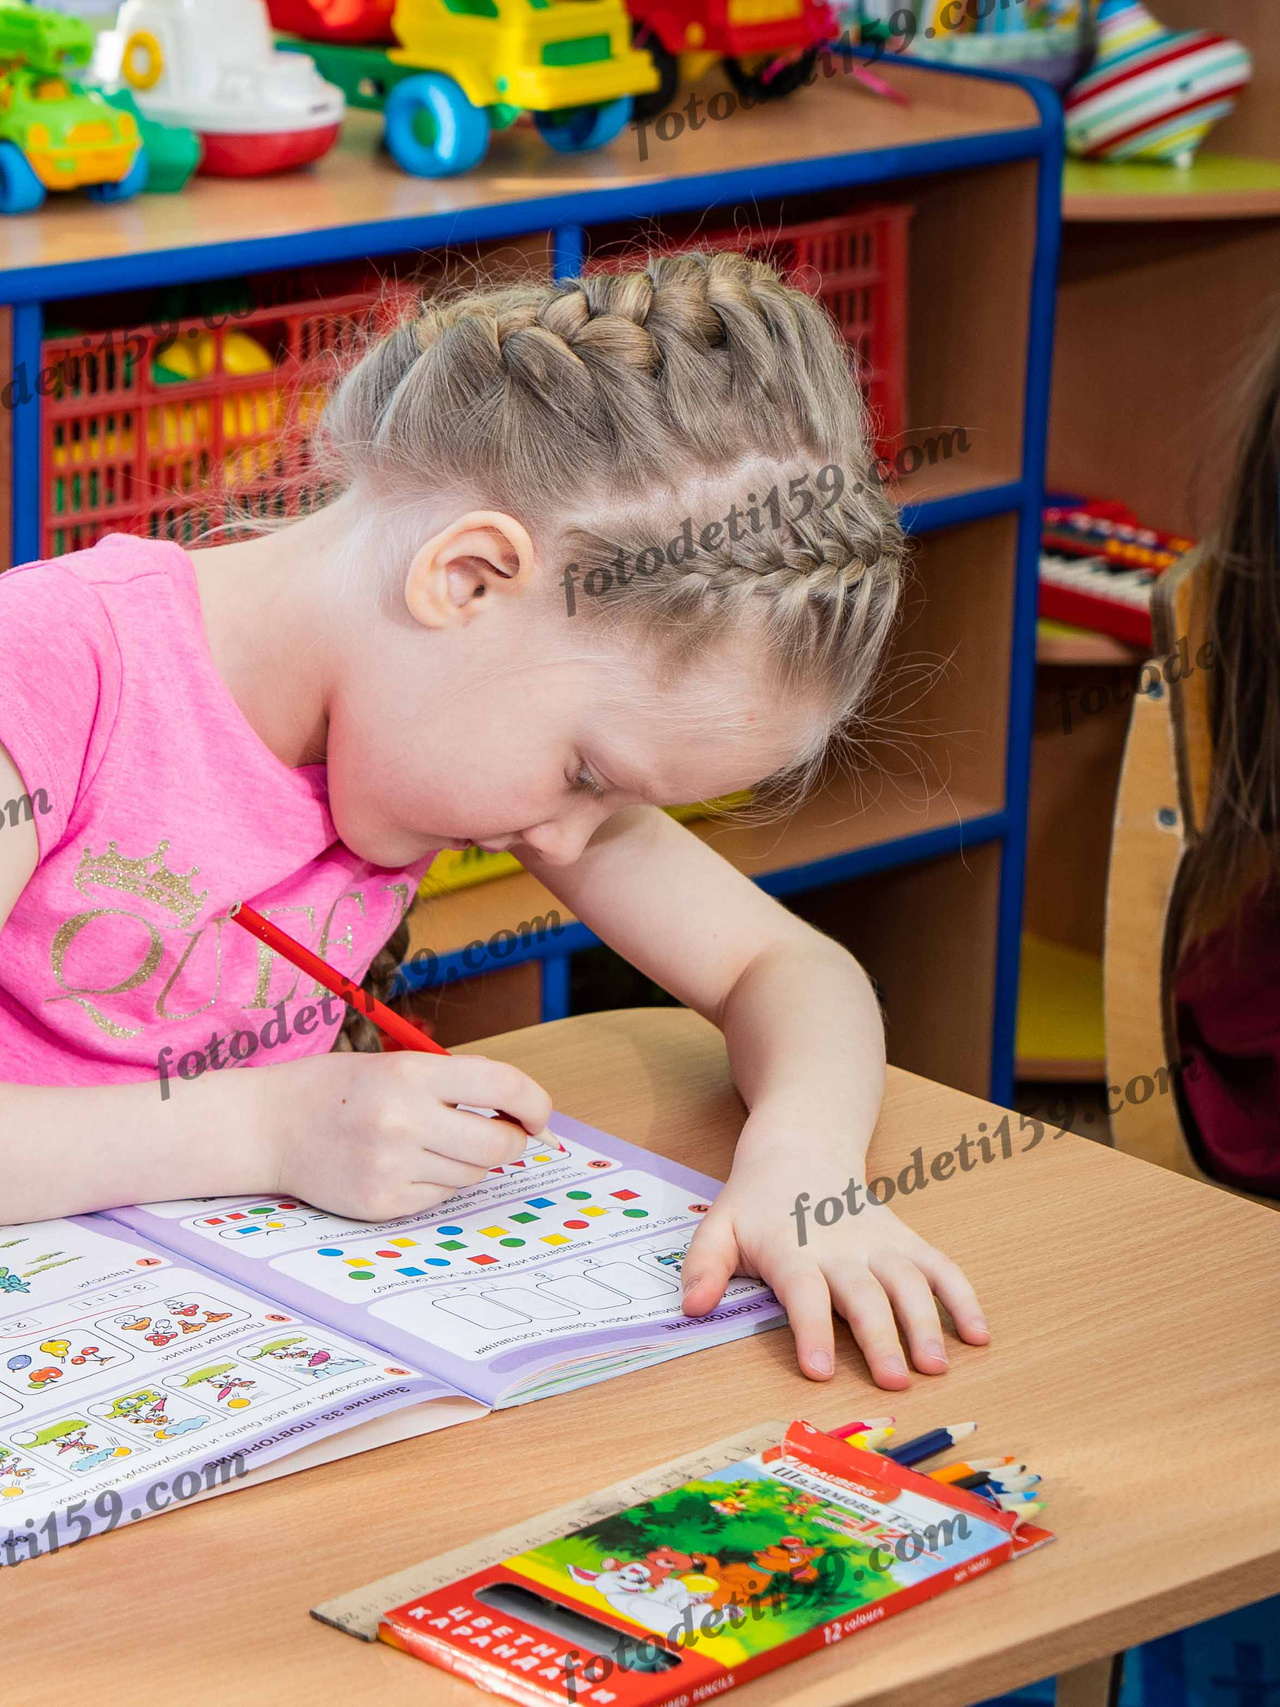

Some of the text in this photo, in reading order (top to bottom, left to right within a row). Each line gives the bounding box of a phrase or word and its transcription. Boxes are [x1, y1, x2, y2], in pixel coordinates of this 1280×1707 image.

[46, 882, 416, 1041] QUEE
[488, 1165, 573, 1195] недостающие
[491, 1175, 564, 1200] неизвестно
[564, 1169, 587, 1181] Что
[438, 1200, 477, 1214] целое
[607, 1220, 657, 1241] больше
[657, 1214, 688, 1229] Чего
[528, 1239, 594, 1261] квадратов
[504, 1257, 528, 1269] или
[73, 1267, 136, 1290] Нарисуй:
[371, 1275, 428, 1294] сколько?
[660, 1303, 760, 1332] ПОВТОРЕНИЕ
[205, 1320, 266, 1347] Проведи
[474, 1330, 542, 1356] составляя
[312, 1374, 385, 1402] Расскажи,
[290, 1399, 312, 1413] как
[205, 1386, 411, 1470] Занятие 33. ПОВТОРЕНИЕ
[123, 1439, 208, 1481] пронумеруй
[798, 1463, 877, 1498] BRAUBERG
[823, 1605, 885, 1646] 12 colours
